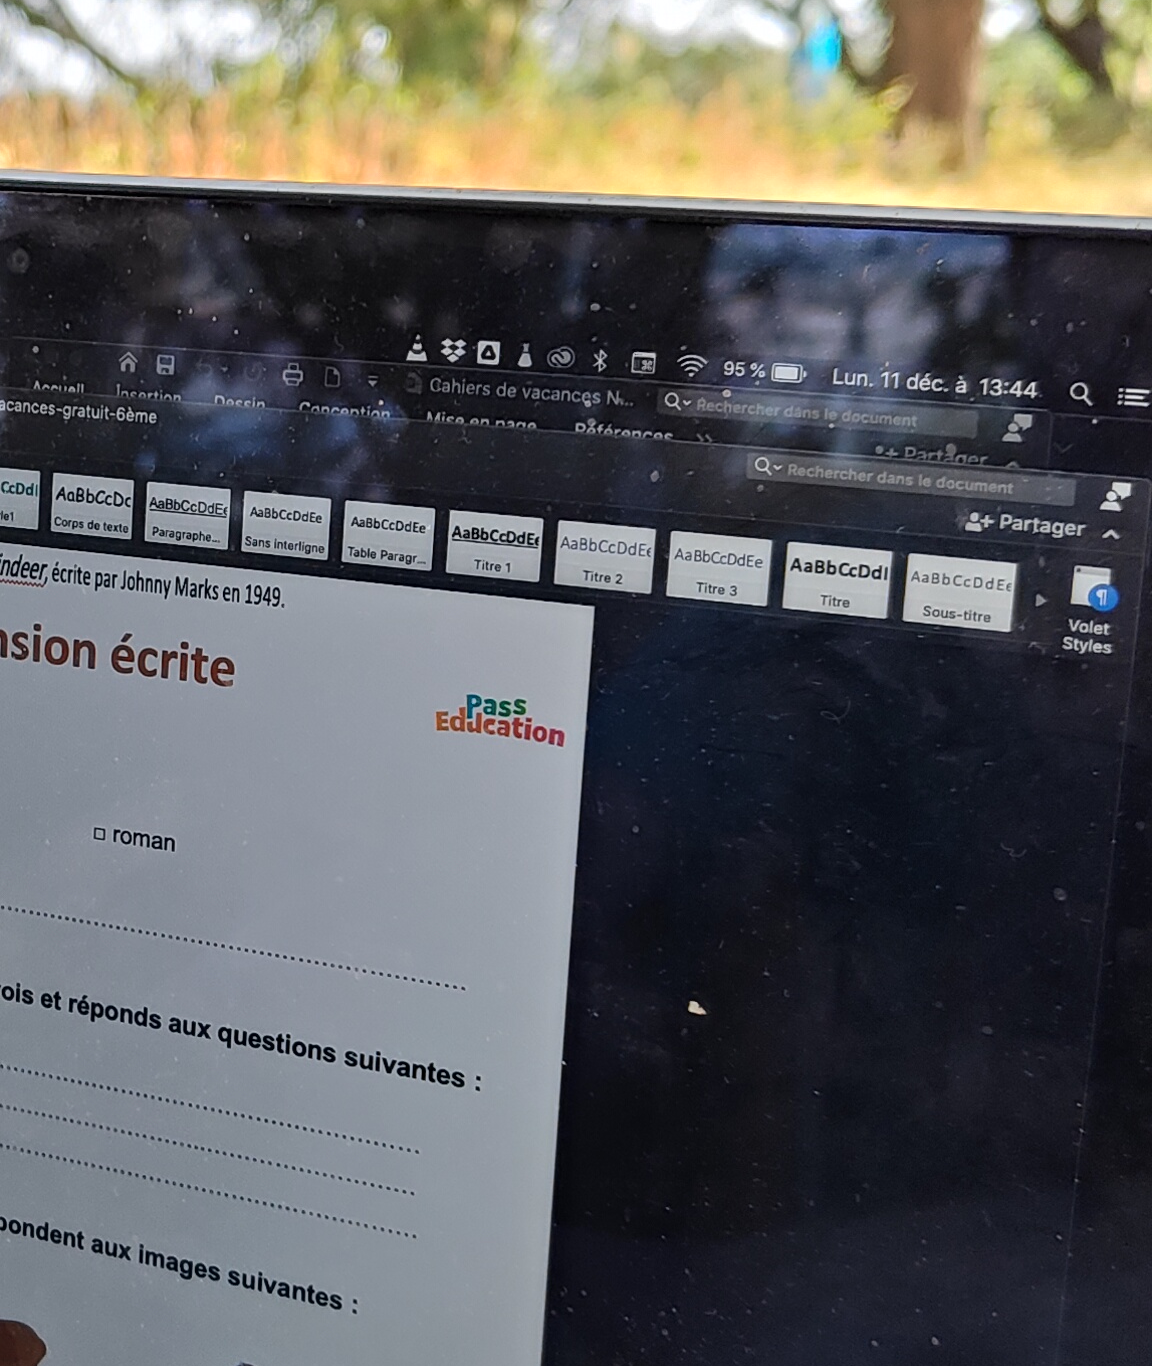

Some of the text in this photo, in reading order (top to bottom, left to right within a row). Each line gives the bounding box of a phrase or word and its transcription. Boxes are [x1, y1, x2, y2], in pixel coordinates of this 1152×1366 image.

[724, 361, 766, 378] 95 %
[429, 377, 601, 403] Cahiers de vacances
[833, 368, 1038, 398] Lun. 11 déc. à 13:44
[696, 397, 918, 427] Rechercher dans document
[787, 463, 1014, 494] Rechercher dans le document
[250, 506, 322, 524] AaBbCcDdEe
[350, 516, 426, 534] AaBbCcDdEe
[54, 517, 129, 534] Corps de texte
[1000, 514, 1086, 538] Partager
[245, 536, 325, 555] Sans interligne
[348, 546, 377, 560] Table
[474, 559, 502, 572] Titre
[674, 548, 764, 569] AaBbCcDdEe
[51, 562, 91, 586] écrite
[95, 571, 118, 592] par
[120, 570, 172, 599] Johnny
[174, 576, 219, 601] Marks
[222, 586, 240, 603] en
[244, 584, 286, 609] 1949.
[583, 570, 623, 585] Titre 2
[696, 582, 738, 596] Titre 3
[820, 594, 850, 608] Titre
[923, 606, 991, 623] Sous-titre
[1069, 619, 1110, 635] Volet
[1062, 637, 1113, 654] Styles
[111, 633, 236, 687] écrite
[466, 694, 527, 719] Pass
[436, 706, 565, 747] Education
[113, 826, 177, 853] roman
[40, 992, 62, 1010] et
[68, 995, 162, 1030] réponds
[168, 1014, 211, 1039] aux
[217, 1026, 336, 1063] questions
[344, 1049, 466, 1089] suivantes
[91, 1234, 132, 1262] aux
[137, 1243, 221, 1281] images
[227, 1267, 343, 1312] suivantes
